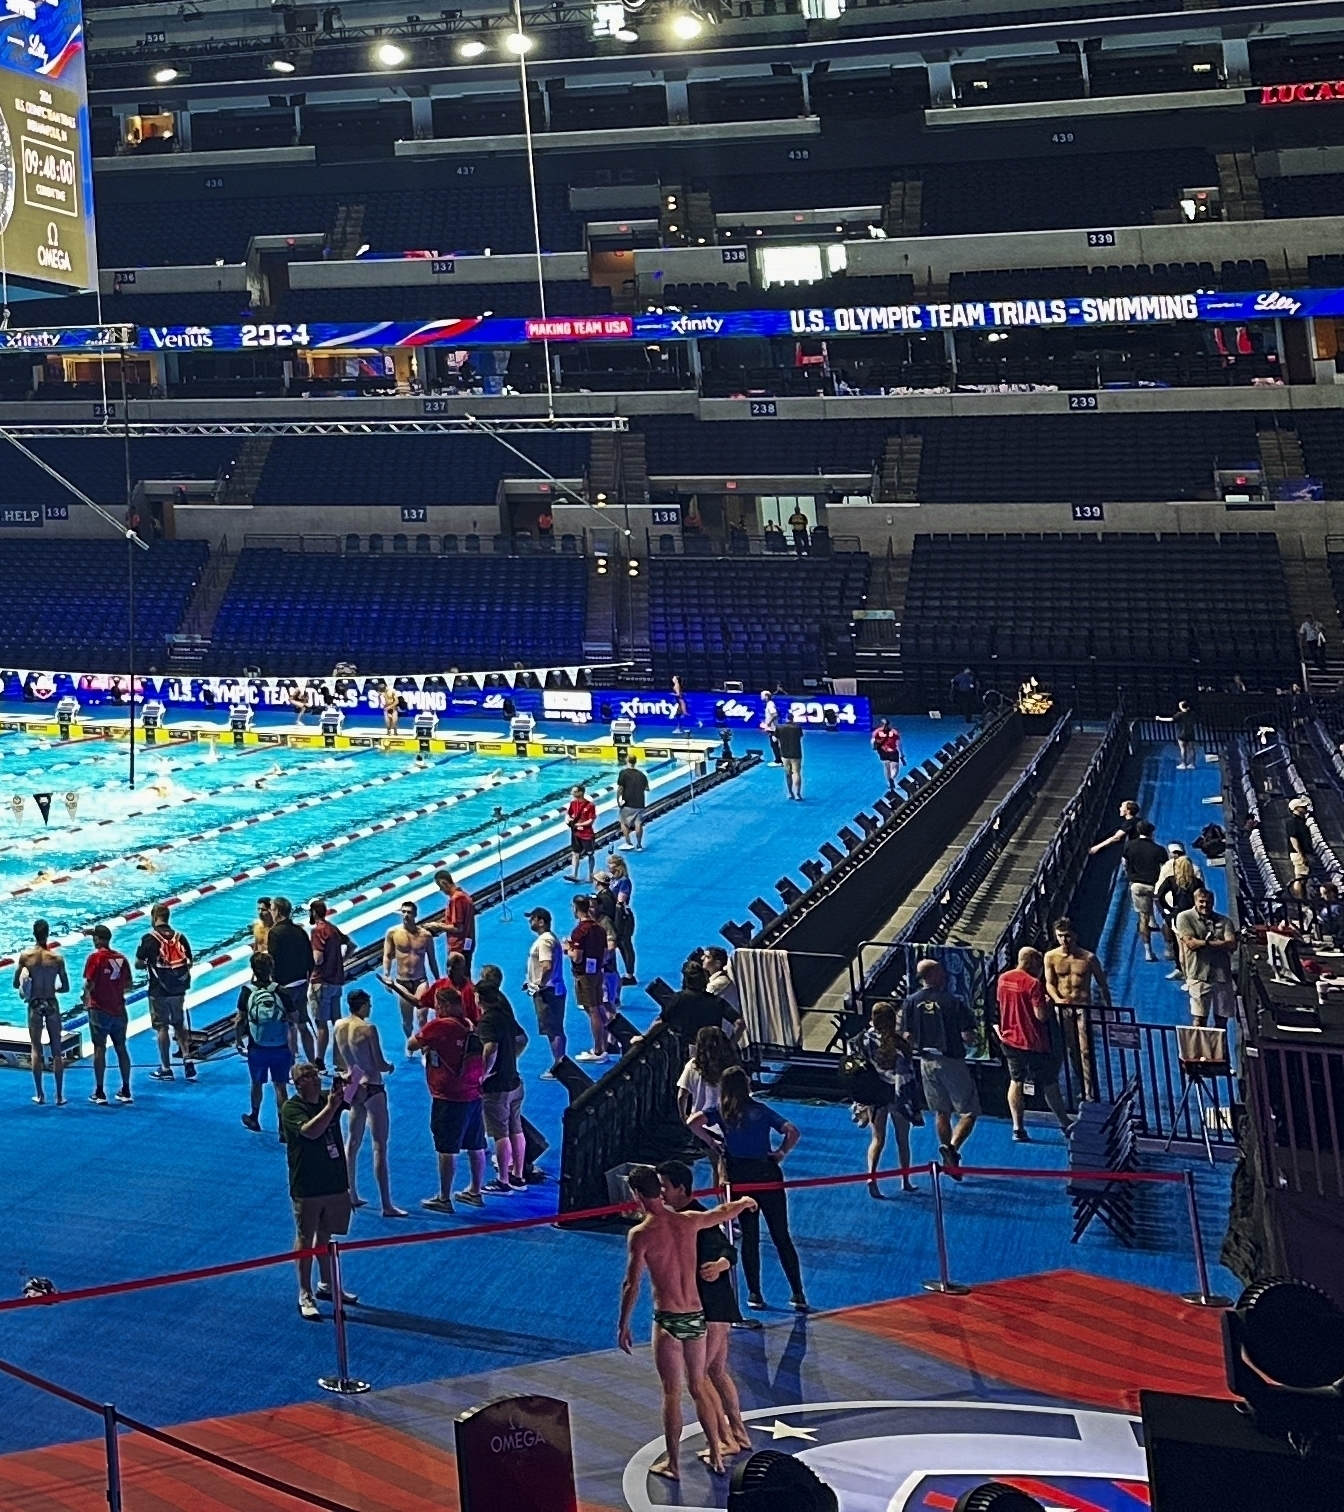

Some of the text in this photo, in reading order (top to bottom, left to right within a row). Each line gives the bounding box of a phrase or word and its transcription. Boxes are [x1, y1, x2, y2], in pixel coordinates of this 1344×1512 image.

[1052, 132, 1074, 143] 439
[25, 148, 74, 186] 09:48:00
[456, 166, 475, 176] 437
[1089, 234, 1113, 245] 339
[37, 245, 72, 272] OMEGA
[723, 249, 746, 262] 338
[790, 309, 831, 333] U.S.
[835, 306, 922, 331] OLYMPIC
[926, 303, 986, 329] TEAM
[1253, 291, 1302, 315] Lilly
[529, 321, 572, 337] MAKING
[573, 320, 602, 335] TEAM
[604, 319, 629, 335] USA
[671, 316, 724, 334] xfinity
[149, 327, 214, 349] Venus
[240, 324, 311, 346] 2024
[425, 401, 446, 412] 237
[751, 402, 775, 415] 238
[1071, 396, 1096, 408] 239
[46, 507, 67, 518] 136
[402, 508, 425, 520] 137
[653, 510, 677, 523] 138
[1074, 505, 1101, 518] 139
[620, 696, 681, 719] xfinity
[490, 1430, 548, 1453] OMEGA
